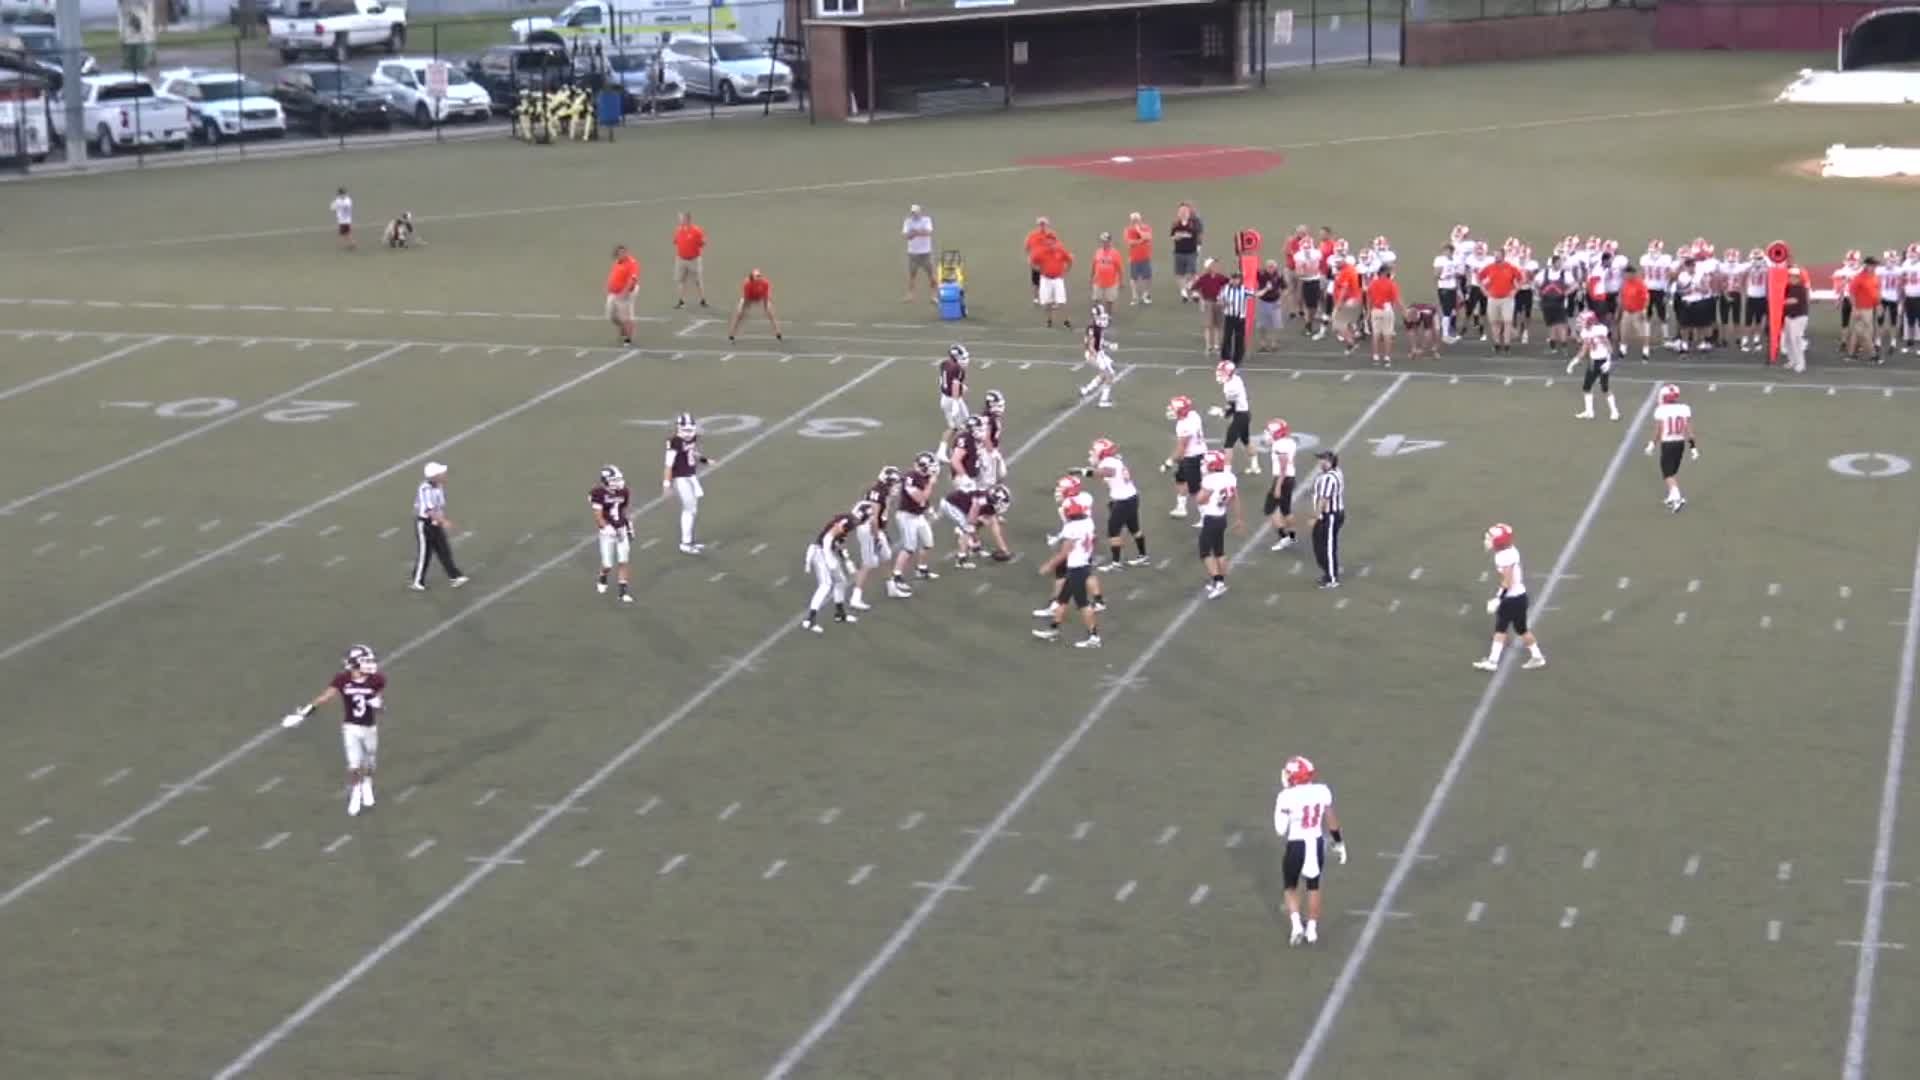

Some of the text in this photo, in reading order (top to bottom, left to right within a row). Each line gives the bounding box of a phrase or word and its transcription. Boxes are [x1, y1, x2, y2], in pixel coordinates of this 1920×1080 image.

[1667, 416, 1685, 436] 10
[351, 693, 367, 718] 3
[1301, 802, 1321, 830] 11
